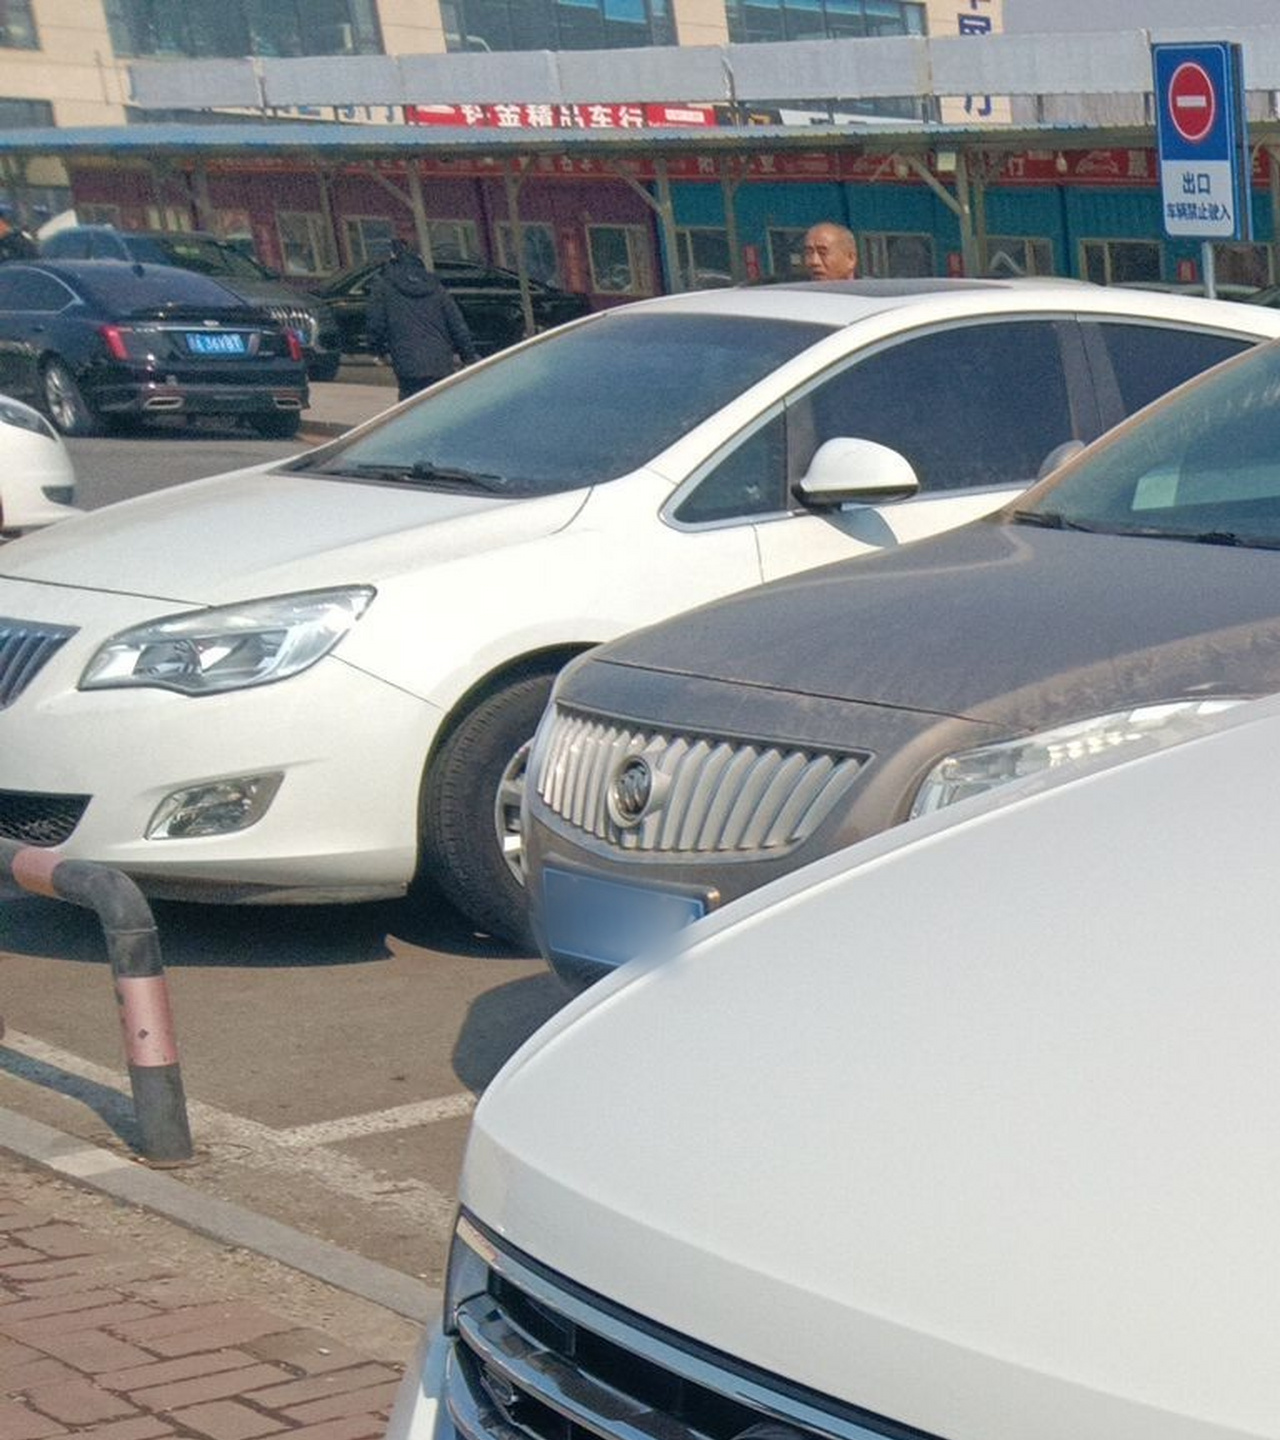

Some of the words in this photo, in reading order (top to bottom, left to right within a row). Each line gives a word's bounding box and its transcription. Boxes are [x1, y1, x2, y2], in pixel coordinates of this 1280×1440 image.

[1182, 170, 1211, 195] 出口
[1166, 202, 1231, 220] 车辆禁止驶入
